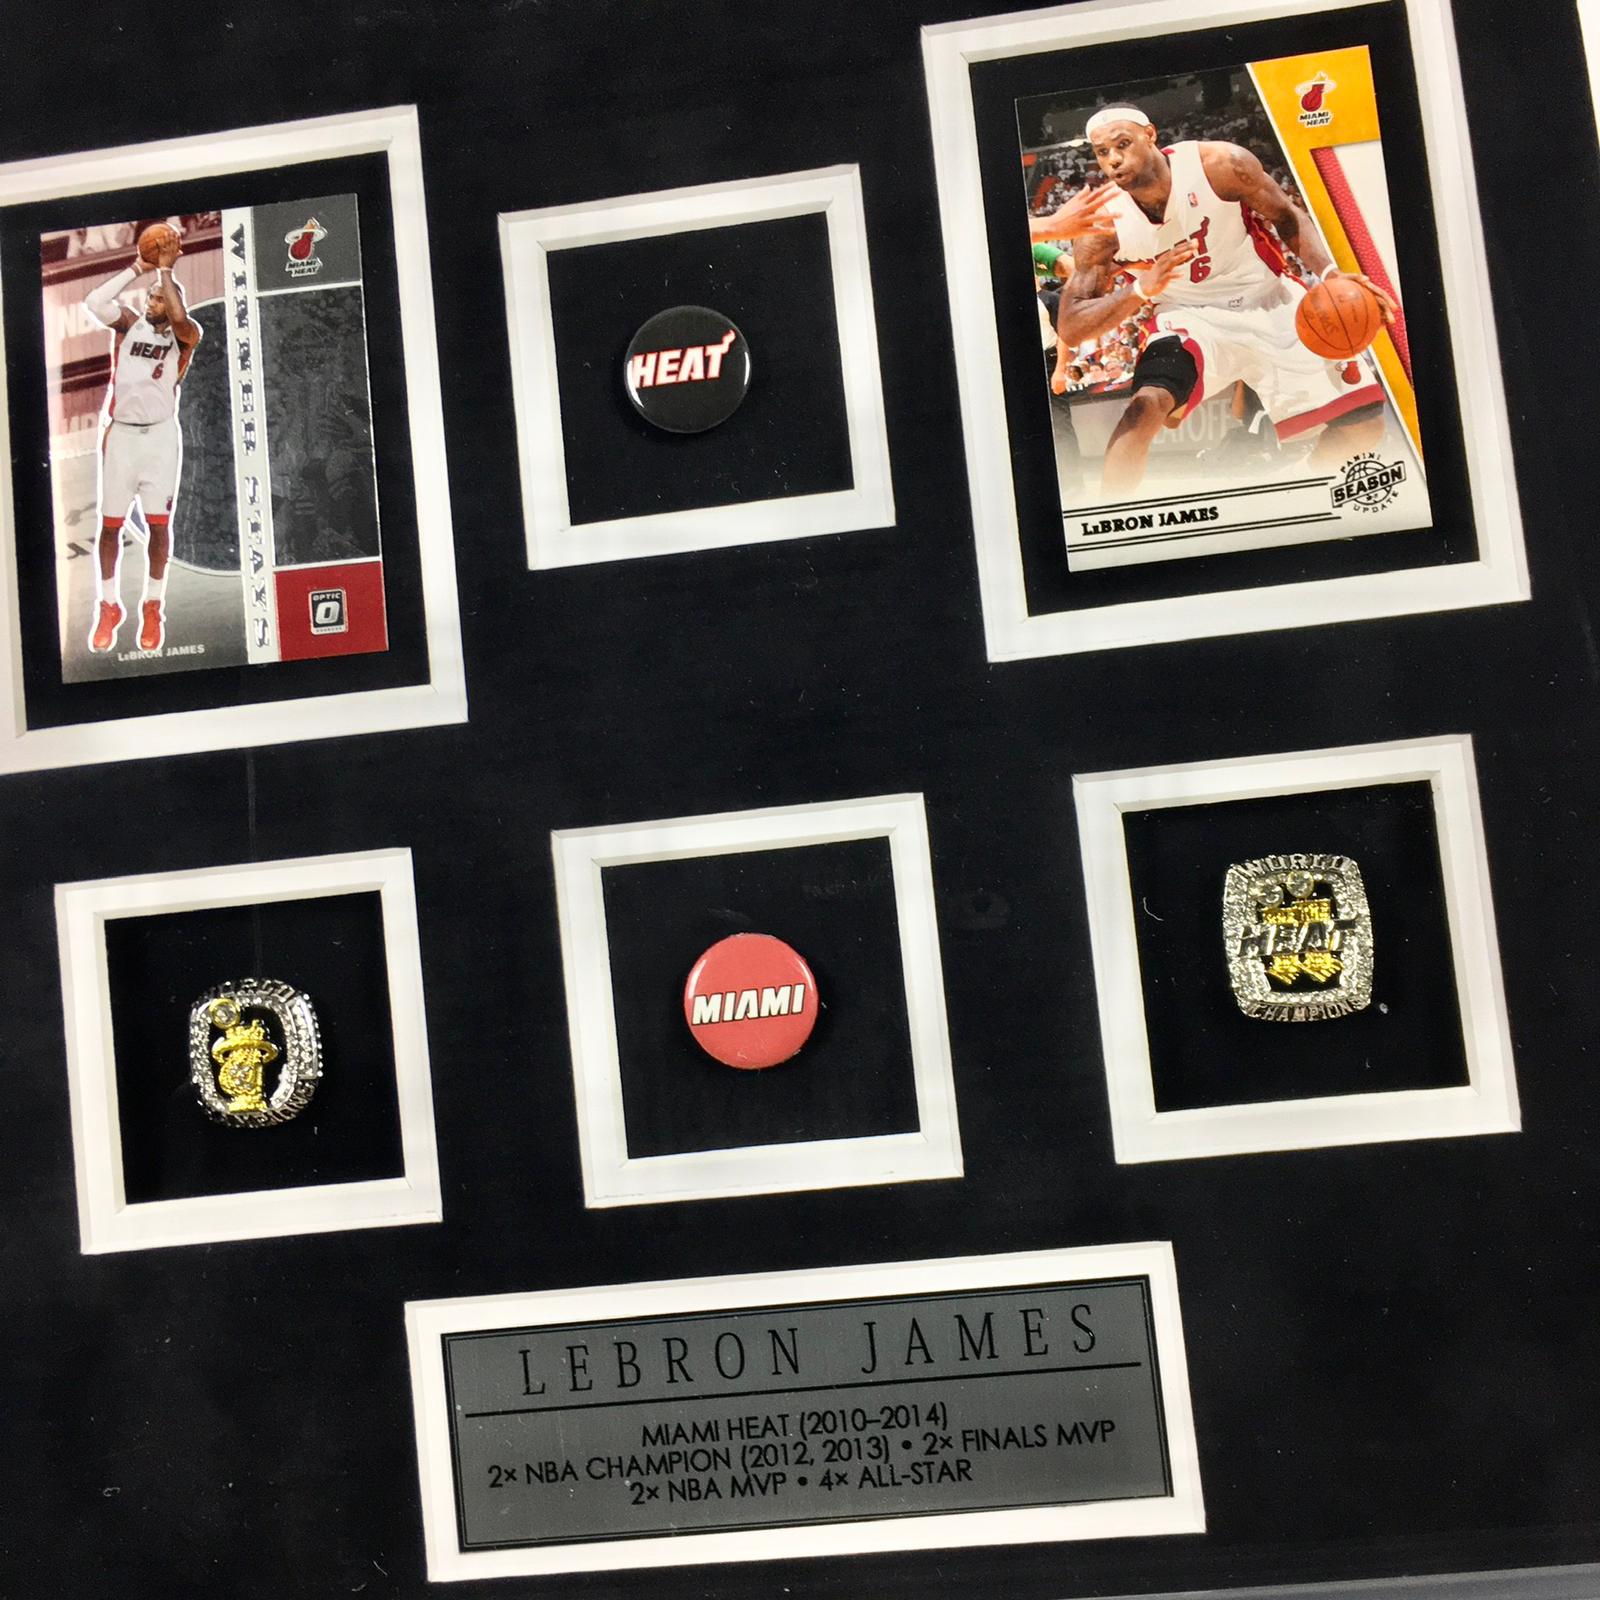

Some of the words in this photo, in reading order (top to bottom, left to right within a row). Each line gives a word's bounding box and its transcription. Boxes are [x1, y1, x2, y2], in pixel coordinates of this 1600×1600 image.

[1299, 111, 1330, 120] MIAMI
[1306, 117, 1330, 126] HEAT
[1190, 255, 1212, 284] 6
[129, 341, 173, 360] HEAT
[630, 328, 737, 390] HEAT
[151, 362, 165, 380] 6
[1340, 452, 1381, 474] PANINI
[1333, 465, 1403, 503] SEASON
[1353, 490, 1399, 513] UPDATE
[1158, 506, 1220, 527] JAMES
[312, 592, 341, 601] OPTIC
[166, 644, 205, 657] JAMES
[690, 983, 806, 1027] MIAMI
[518, 1327, 801, 1396] LEBRON
[860, 1303, 1096, 1374] JAMES
[641, 1419, 720, 1448] MIAMI
[728, 1414, 790, 1442] HEAT
[524, 1459, 580, 1485] NBA
[585, 1447, 732, 1481] CHAMPION
[740, 1442, 816, 1474] (2012,
[823, 1434, 890, 1465] 2013)
[961, 1424, 1048, 1453] FINALS
[1056, 1419, 1116, 1447] MVP
[667, 1477, 723, 1504] NBA
[729, 1472, 788, 1499] MVP
[857, 1458, 973, 1490] ALL-STAR
